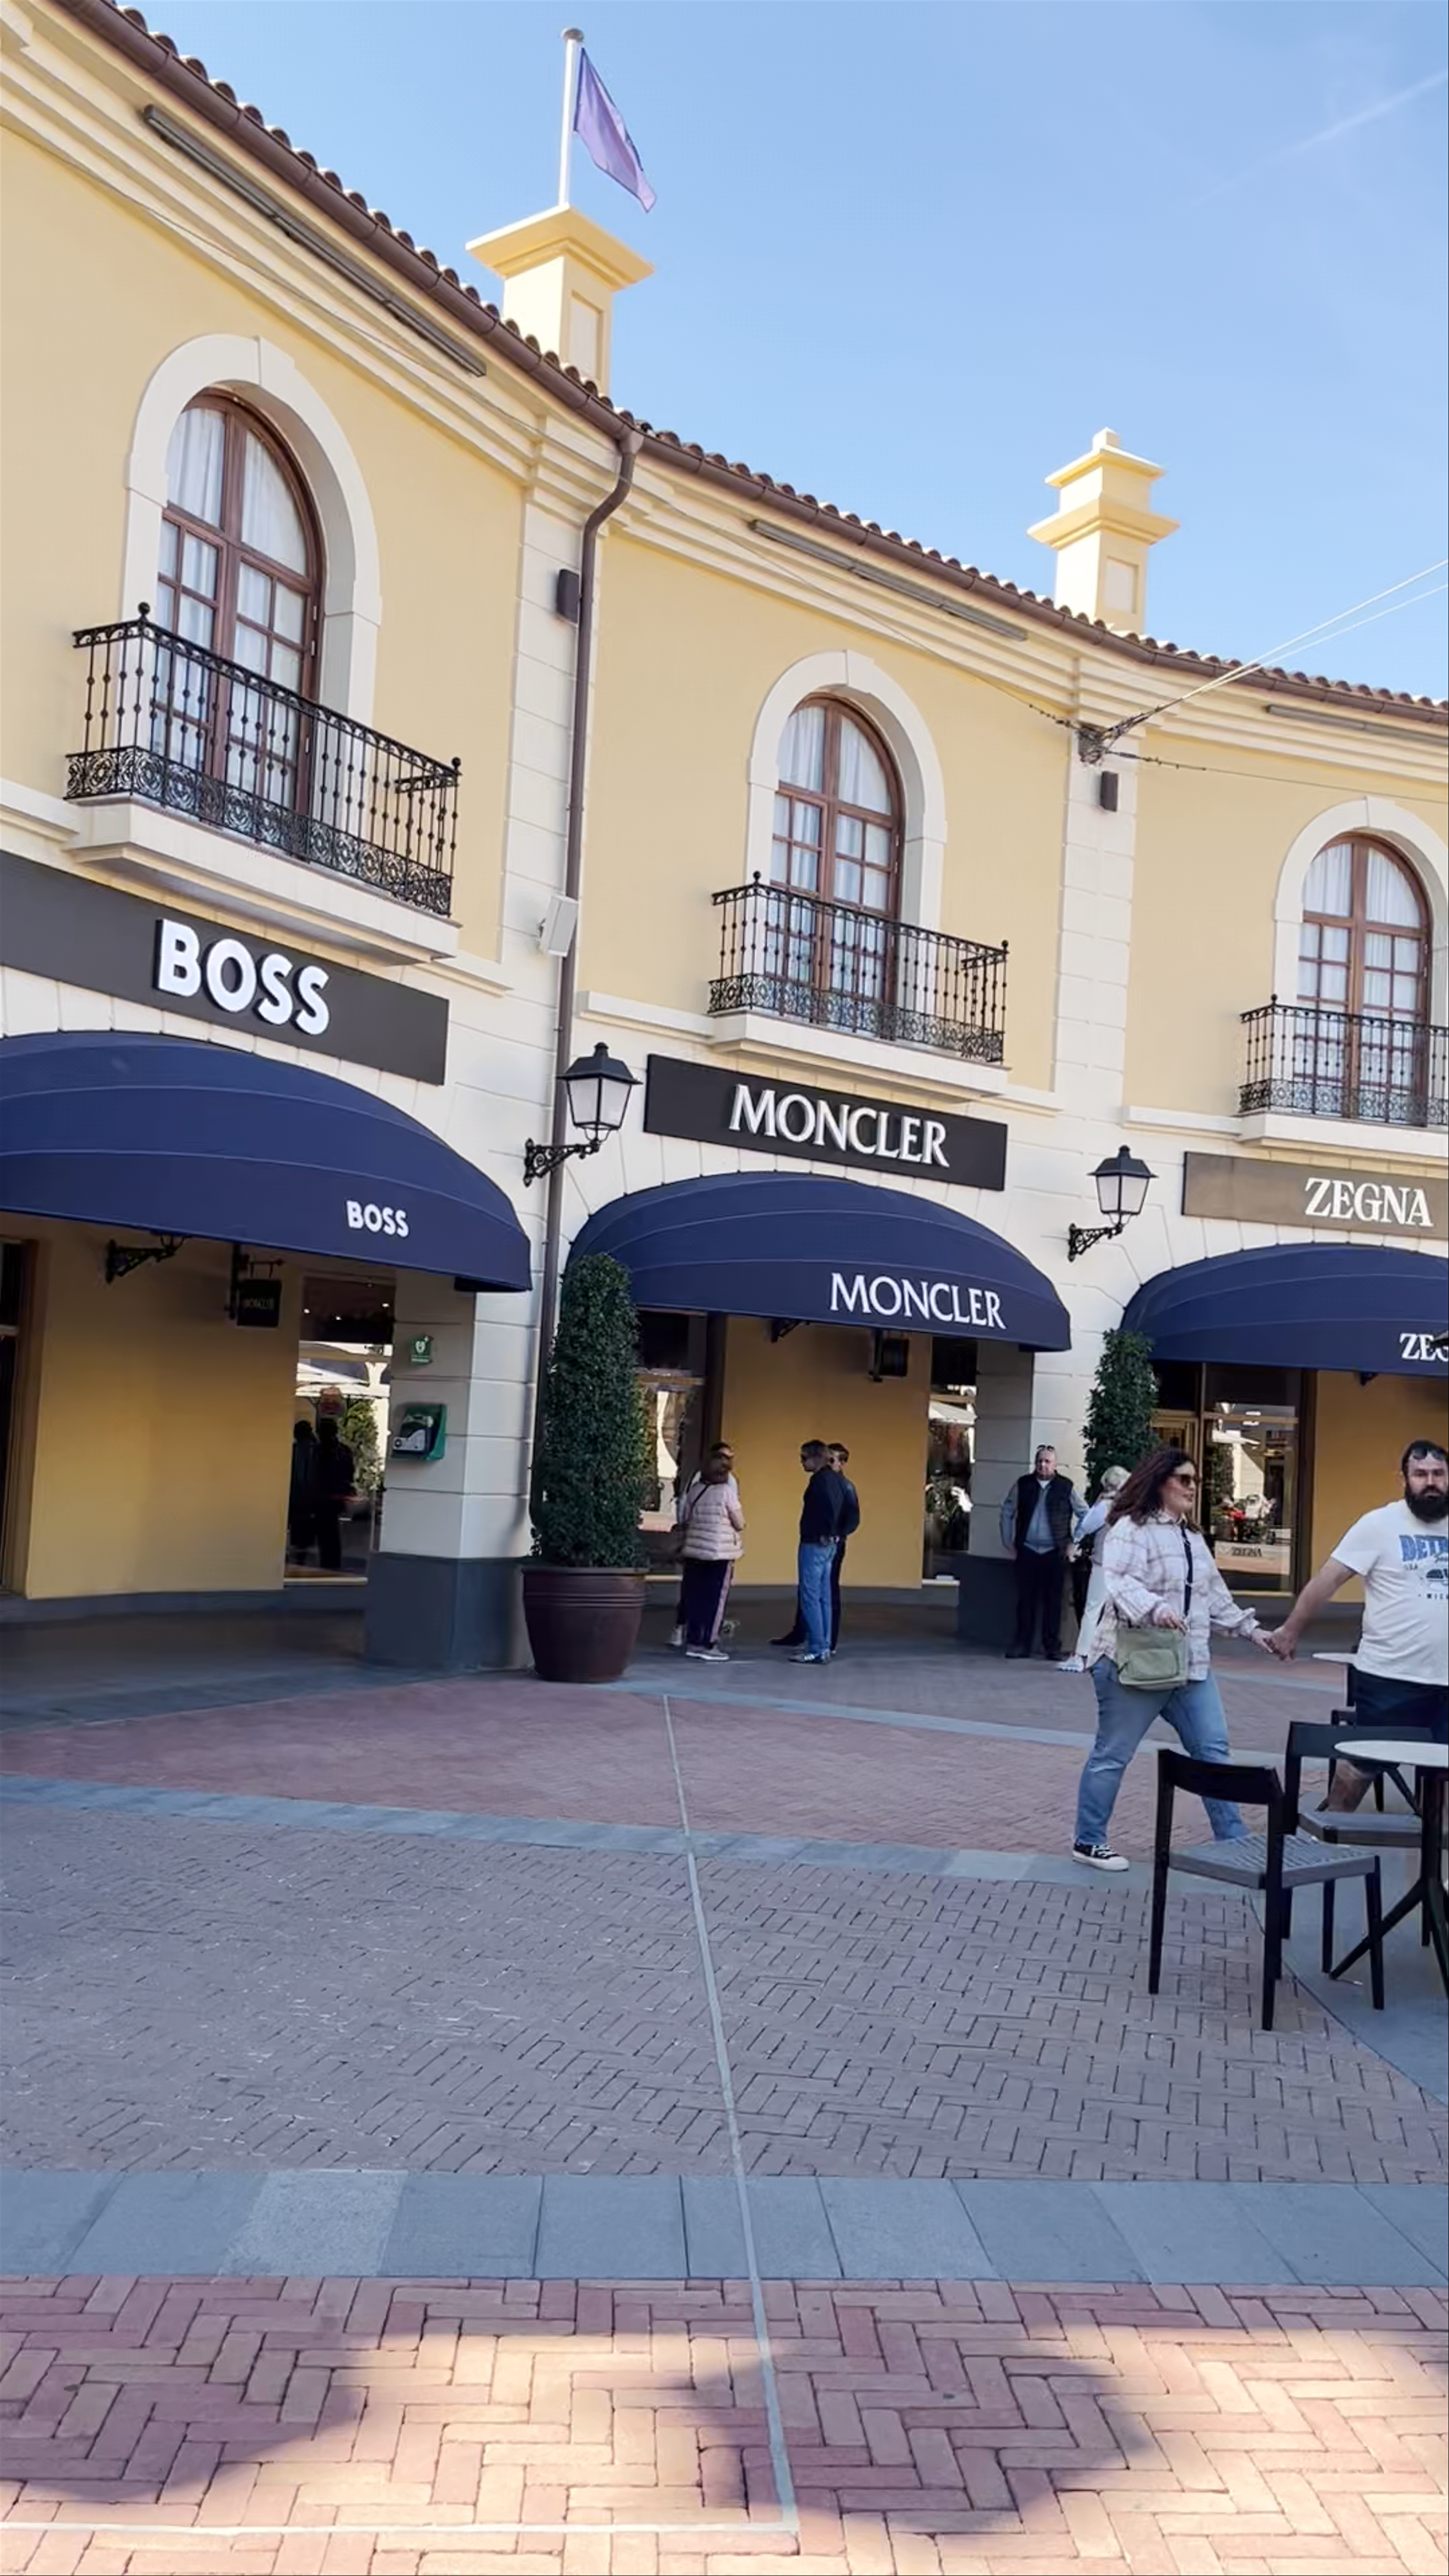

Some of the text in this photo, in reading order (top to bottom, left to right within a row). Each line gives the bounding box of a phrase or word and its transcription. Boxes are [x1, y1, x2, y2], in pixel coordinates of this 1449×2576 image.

[157, 918, 330, 1035] BOSS
[729, 1084, 950, 1167] MONCLER
[347, 1201, 409, 1237] BOSS
[1304, 1177, 1434, 1227] ZEGNA
[831, 1273, 1006, 1329] MONCLER
